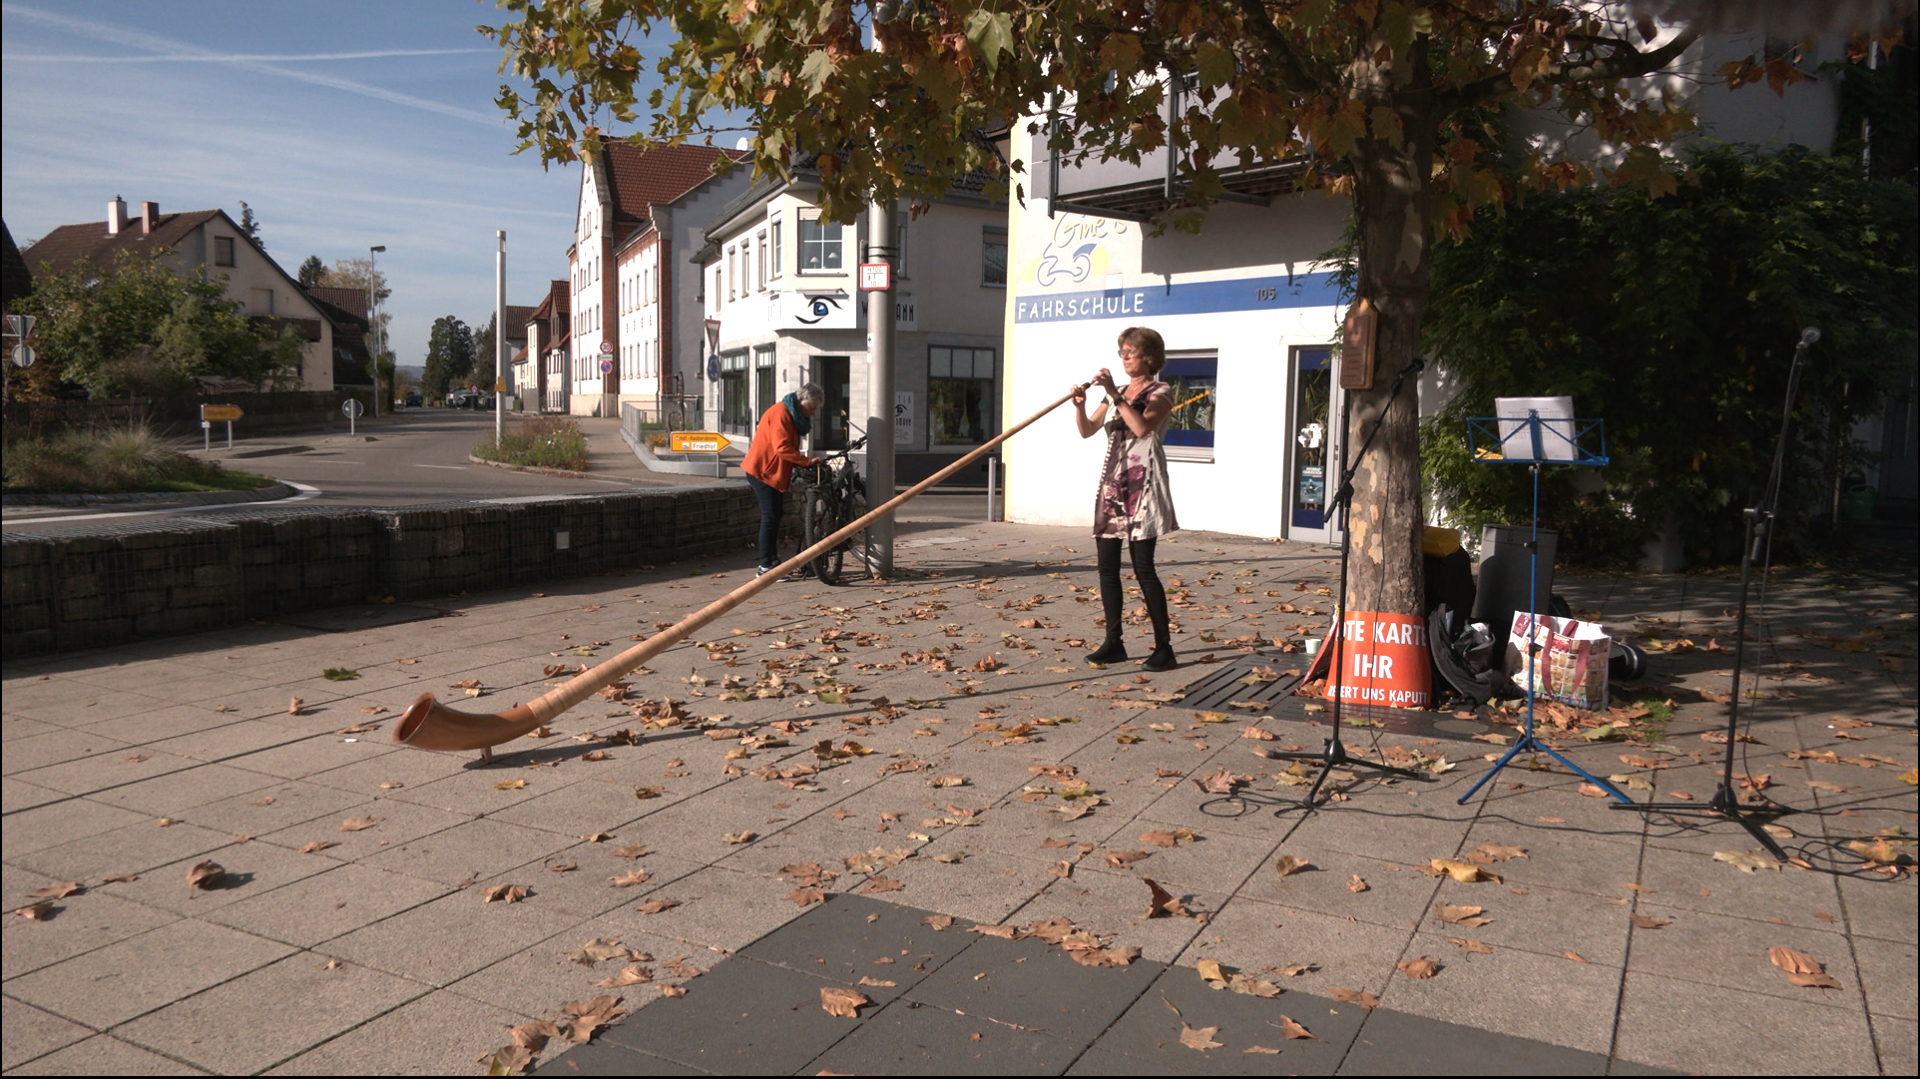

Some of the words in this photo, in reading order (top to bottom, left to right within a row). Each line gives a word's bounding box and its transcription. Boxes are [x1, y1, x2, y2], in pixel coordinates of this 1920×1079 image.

[1256, 288, 1276, 301] 105
[1018, 293, 1144, 320] FAHRSCHULE
[1354, 653, 1393, 679] IHR
[1361, 687, 1386, 701] UNS
[1389, 689, 1427, 704] KAPUTT
